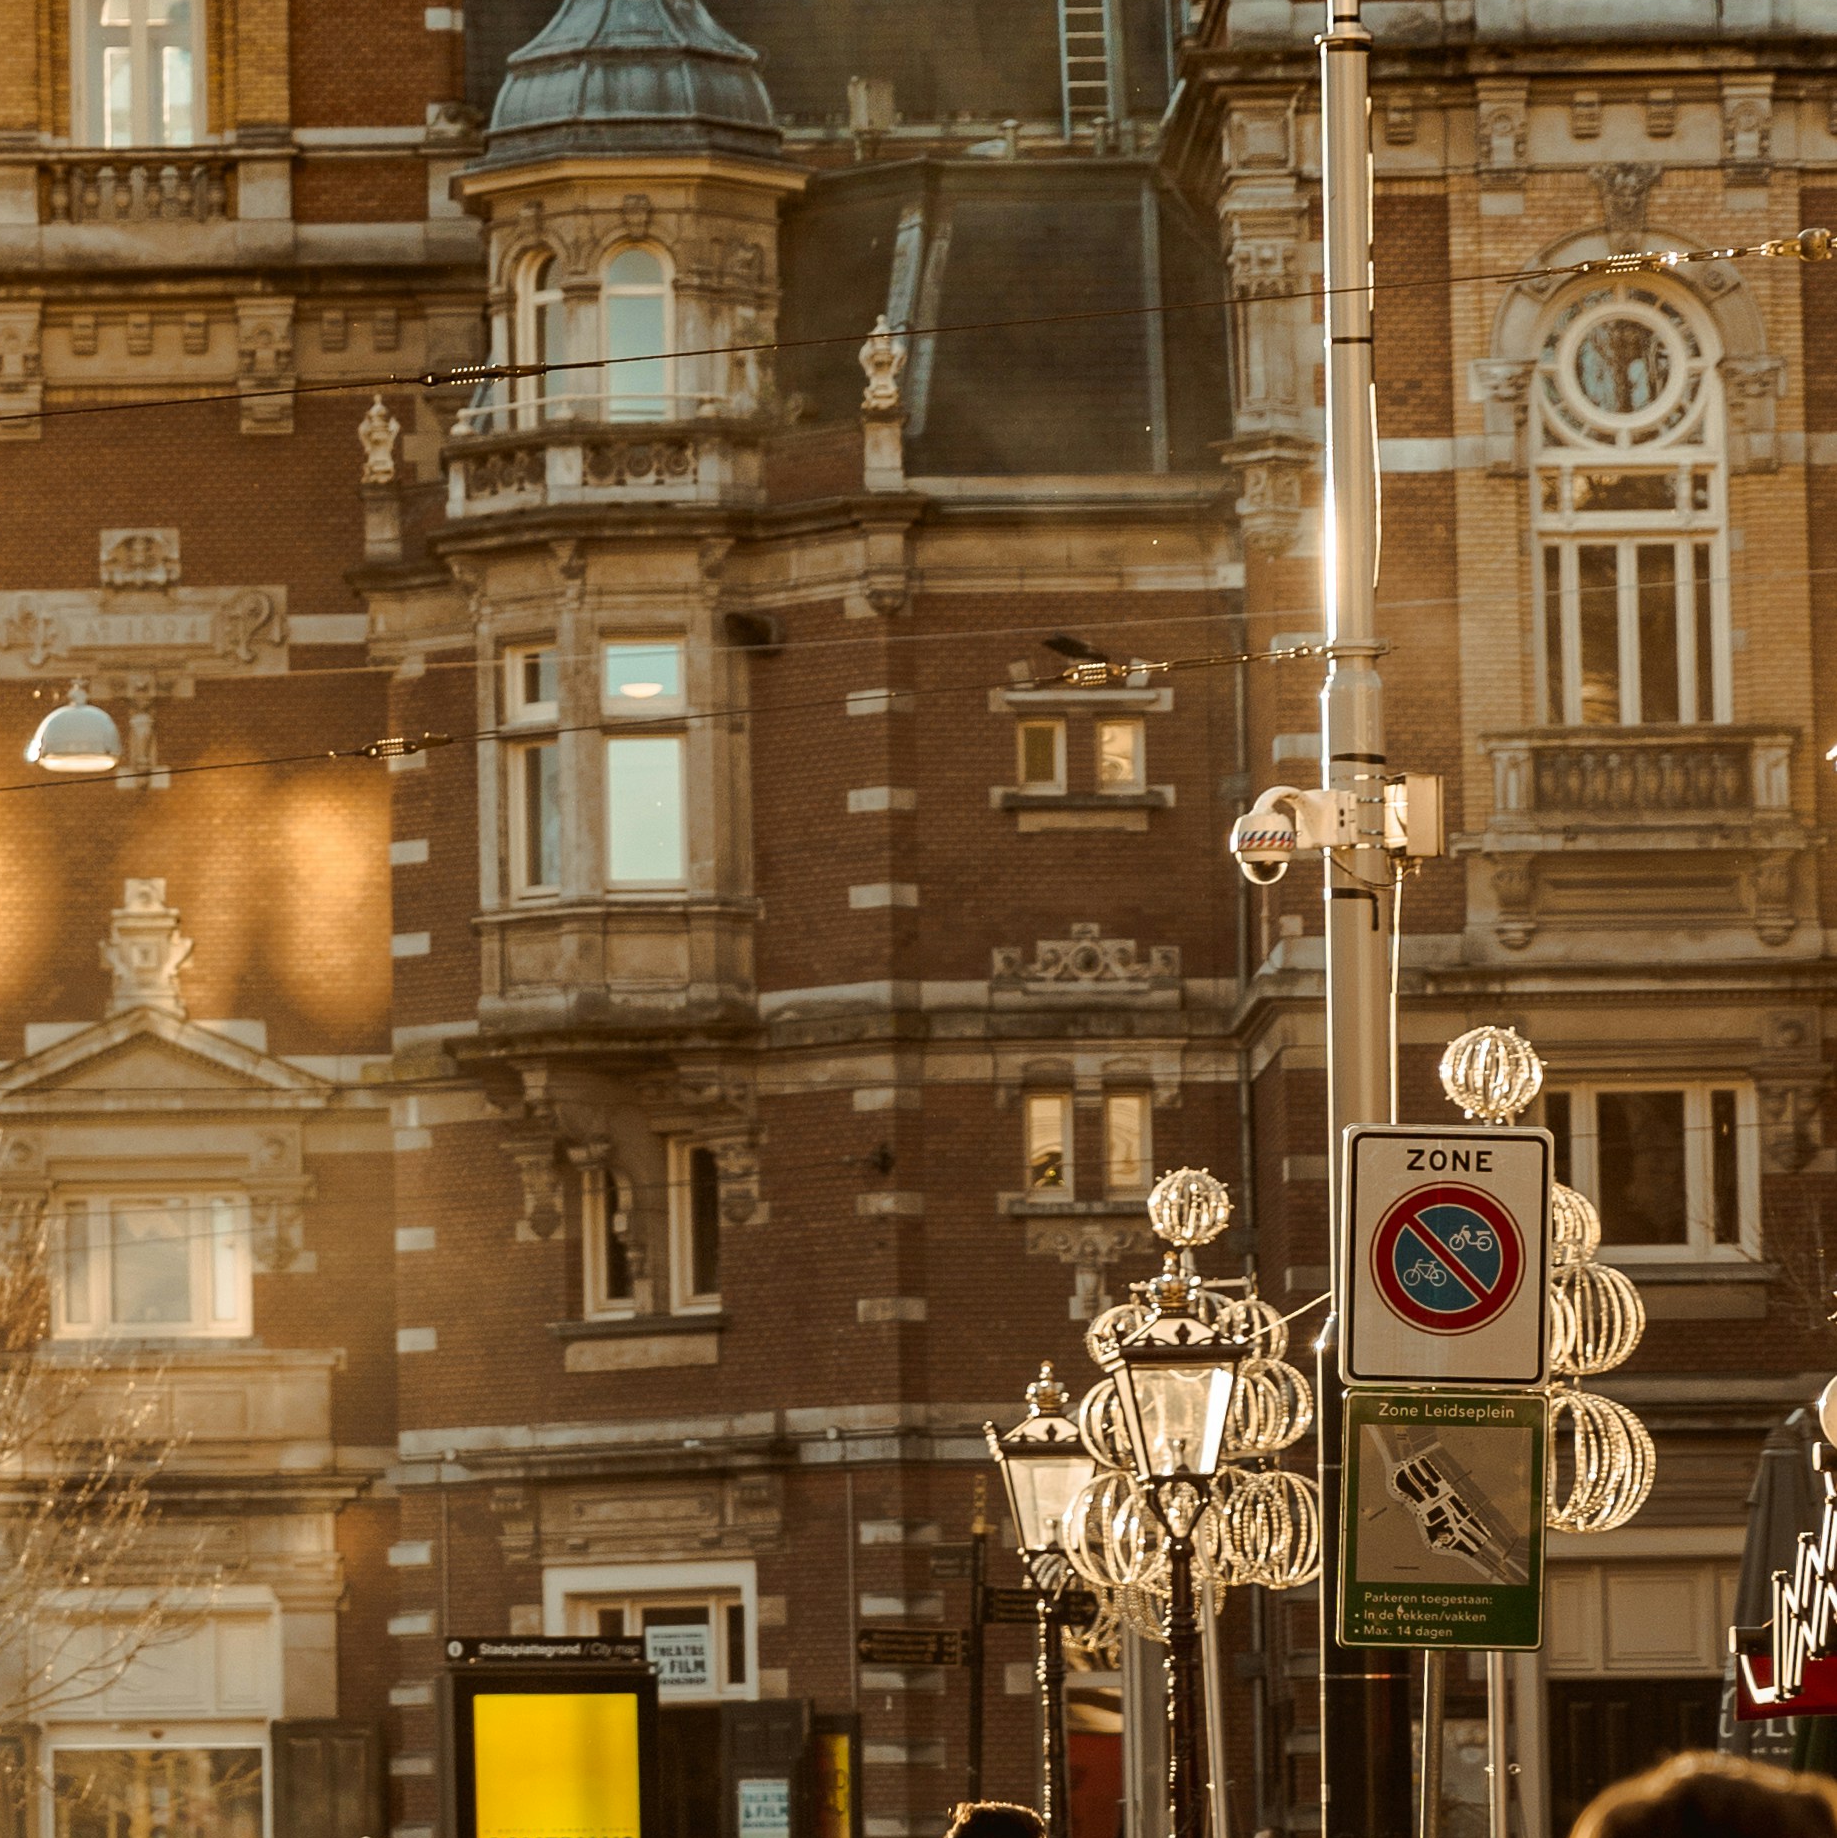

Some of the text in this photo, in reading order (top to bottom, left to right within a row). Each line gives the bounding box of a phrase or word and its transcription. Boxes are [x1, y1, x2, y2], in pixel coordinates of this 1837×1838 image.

[1406, 1149, 1493, 1173] ZONE
[1378, 1402, 1515, 1422] Zone Leidseplein
[1364, 1592, 1493, 1607] Parkeren toegestaan:
[1364, 1610, 1375, 1620] In
[1378, 1610, 1394, 1621] de
[1363, 1625, 1453, 1640] Max. 14 dagen
[479, 1643, 581, 1658] Stadsplattegrond
[590, 1642, 611, 1657] City
[614, 1645, 641, 1658] map
[670, 1659, 706, 1673] FILM
